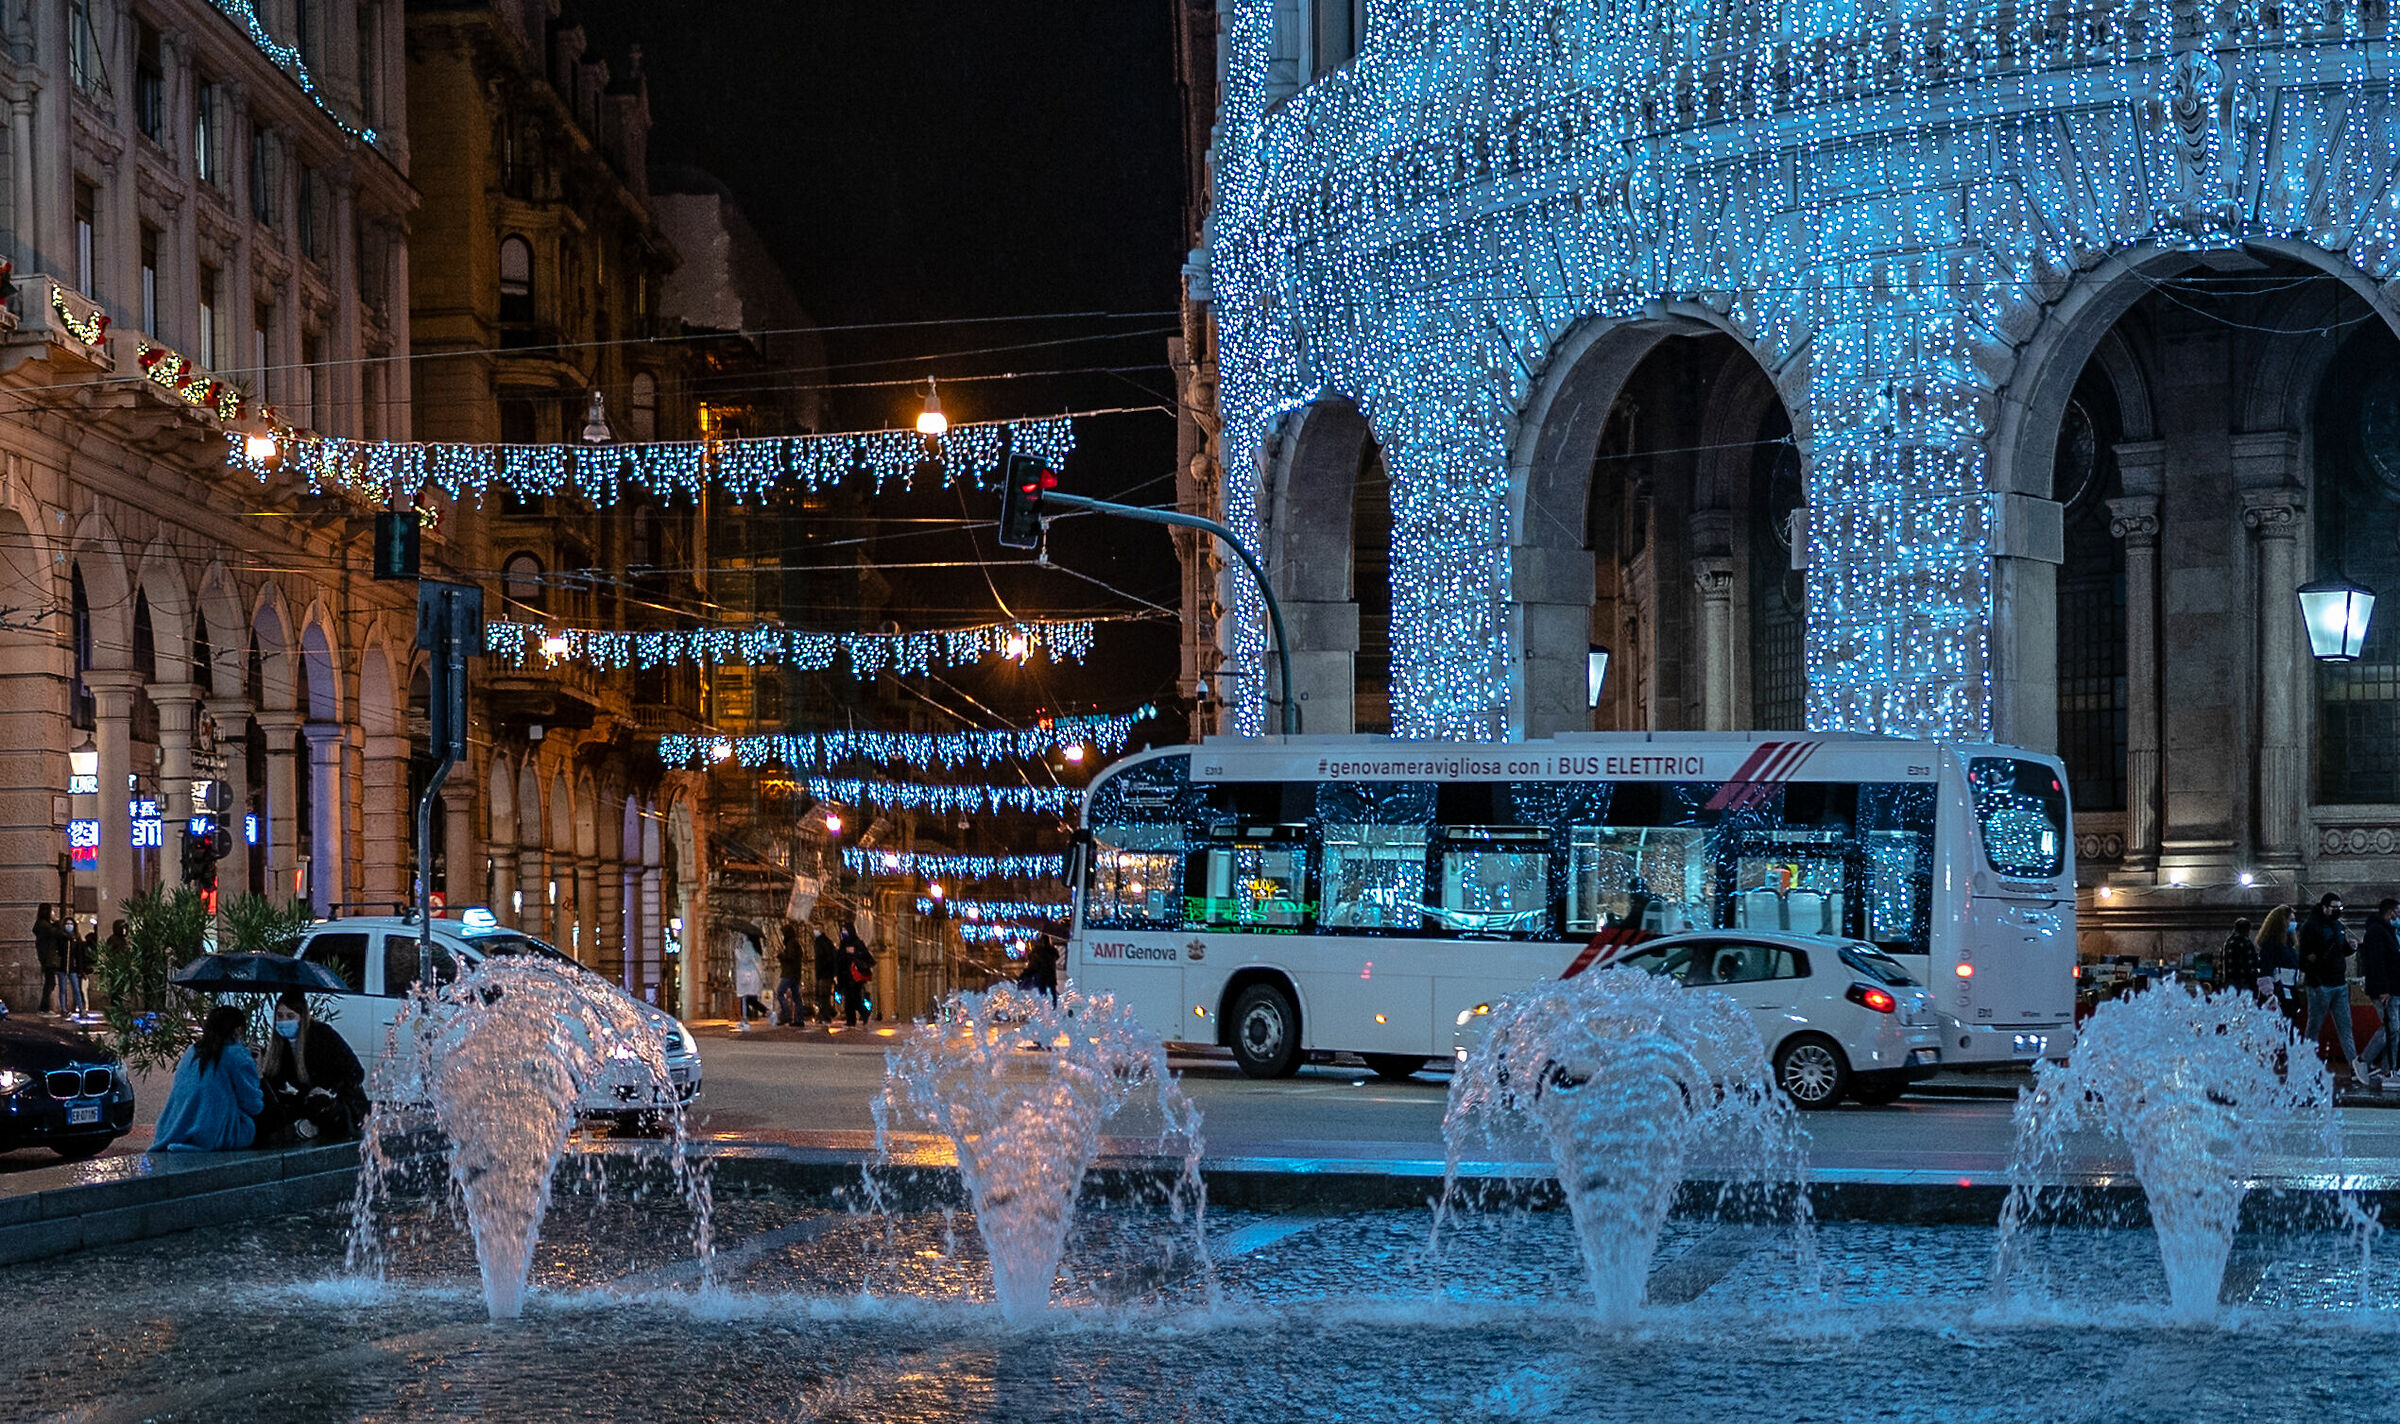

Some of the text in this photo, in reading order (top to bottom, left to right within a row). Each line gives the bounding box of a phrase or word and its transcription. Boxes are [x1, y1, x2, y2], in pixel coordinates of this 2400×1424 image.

[1318, 756, 1704, 778] #genovameravigliosa con i BUS ELETTRICI
